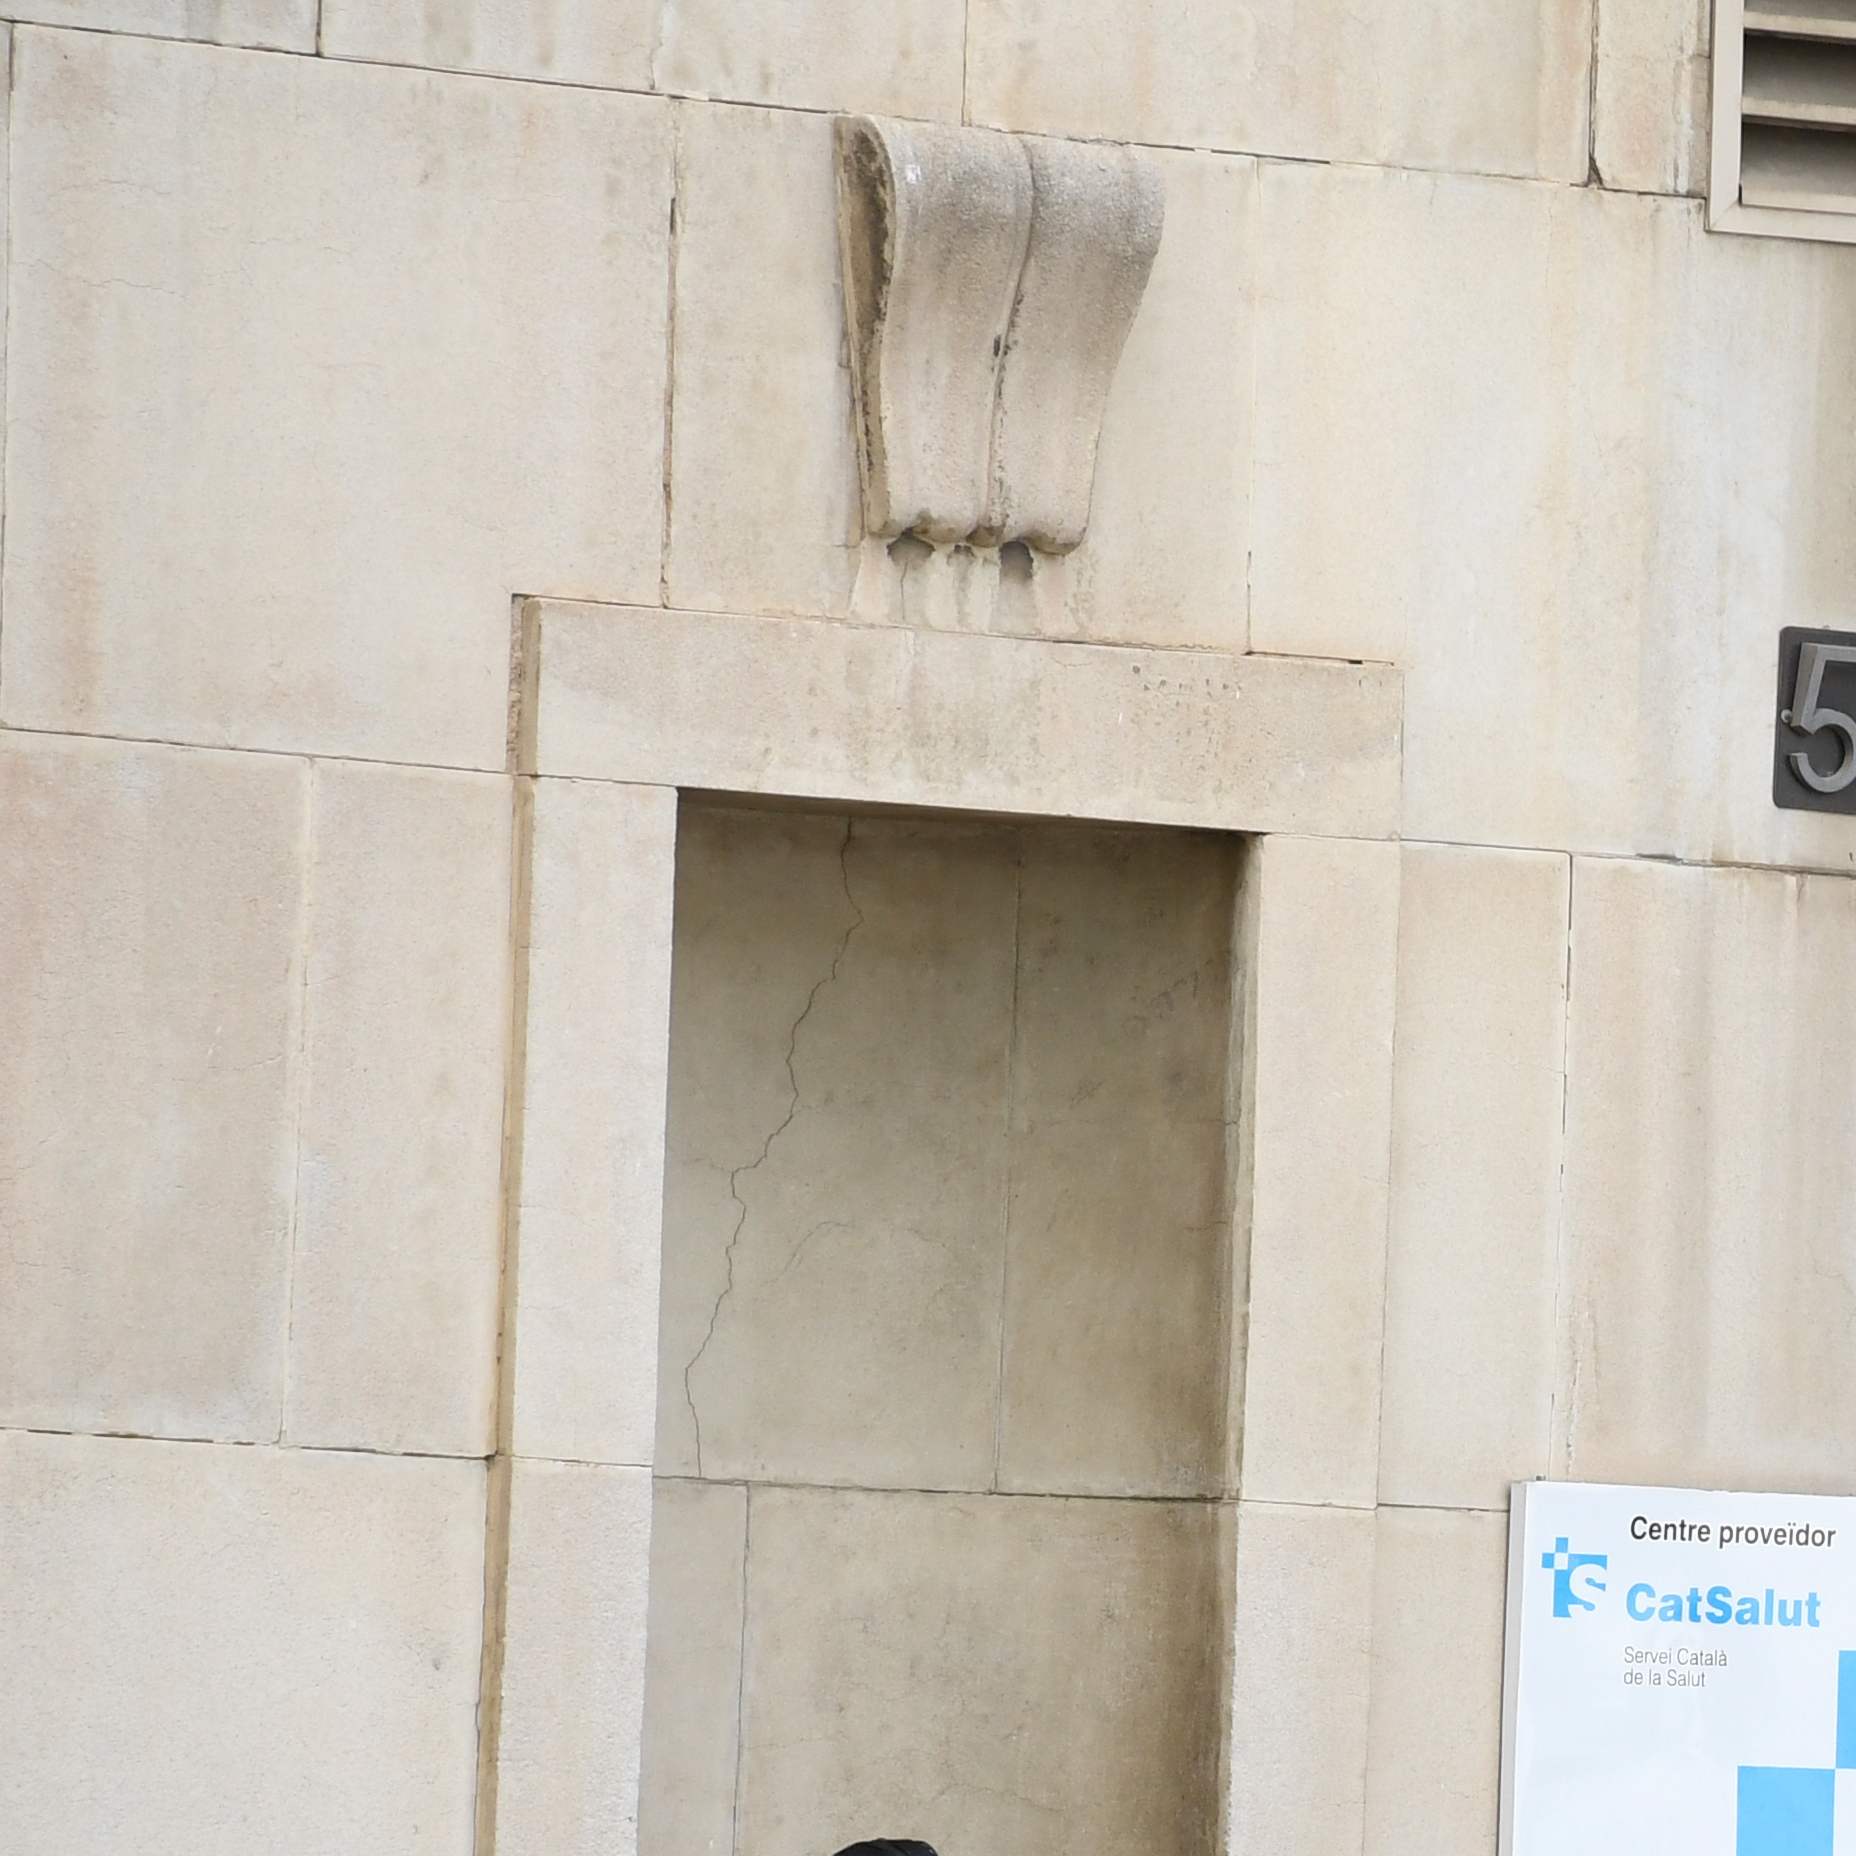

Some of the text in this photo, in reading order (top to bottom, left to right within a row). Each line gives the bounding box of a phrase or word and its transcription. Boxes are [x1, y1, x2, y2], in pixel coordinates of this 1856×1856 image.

[1630, 1516, 1837, 1549] Centre proveïdor
[1626, 1582, 1821, 1628] CatSalut
[1624, 1646, 1728, 1667] Servei Català
[1623, 1669, 1706, 1688] de la Salut
